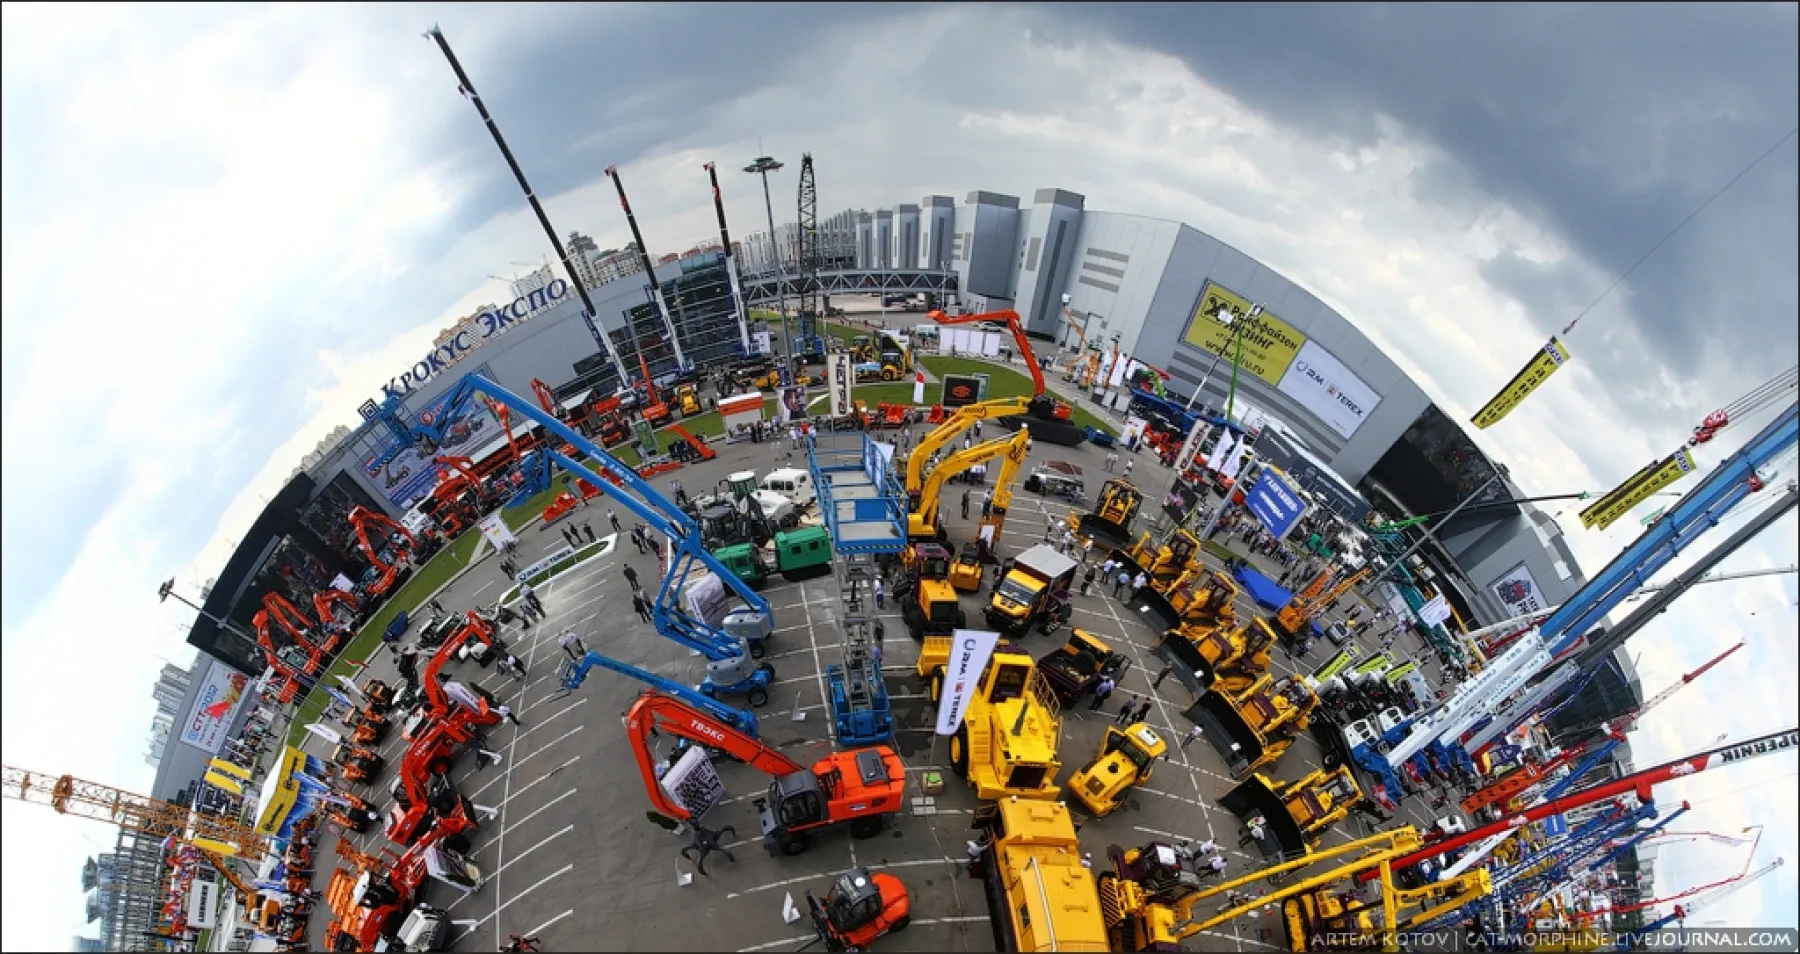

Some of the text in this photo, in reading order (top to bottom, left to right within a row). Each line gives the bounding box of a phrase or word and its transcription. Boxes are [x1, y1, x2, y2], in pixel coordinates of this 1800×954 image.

[380, 278, 567, 399] КРОКУС ЭКСПО
[1336, 391, 1363, 417] TEREX
[947, 694, 963, 728] TEREX
[690, 718, 725, 742] ТВЭКС
